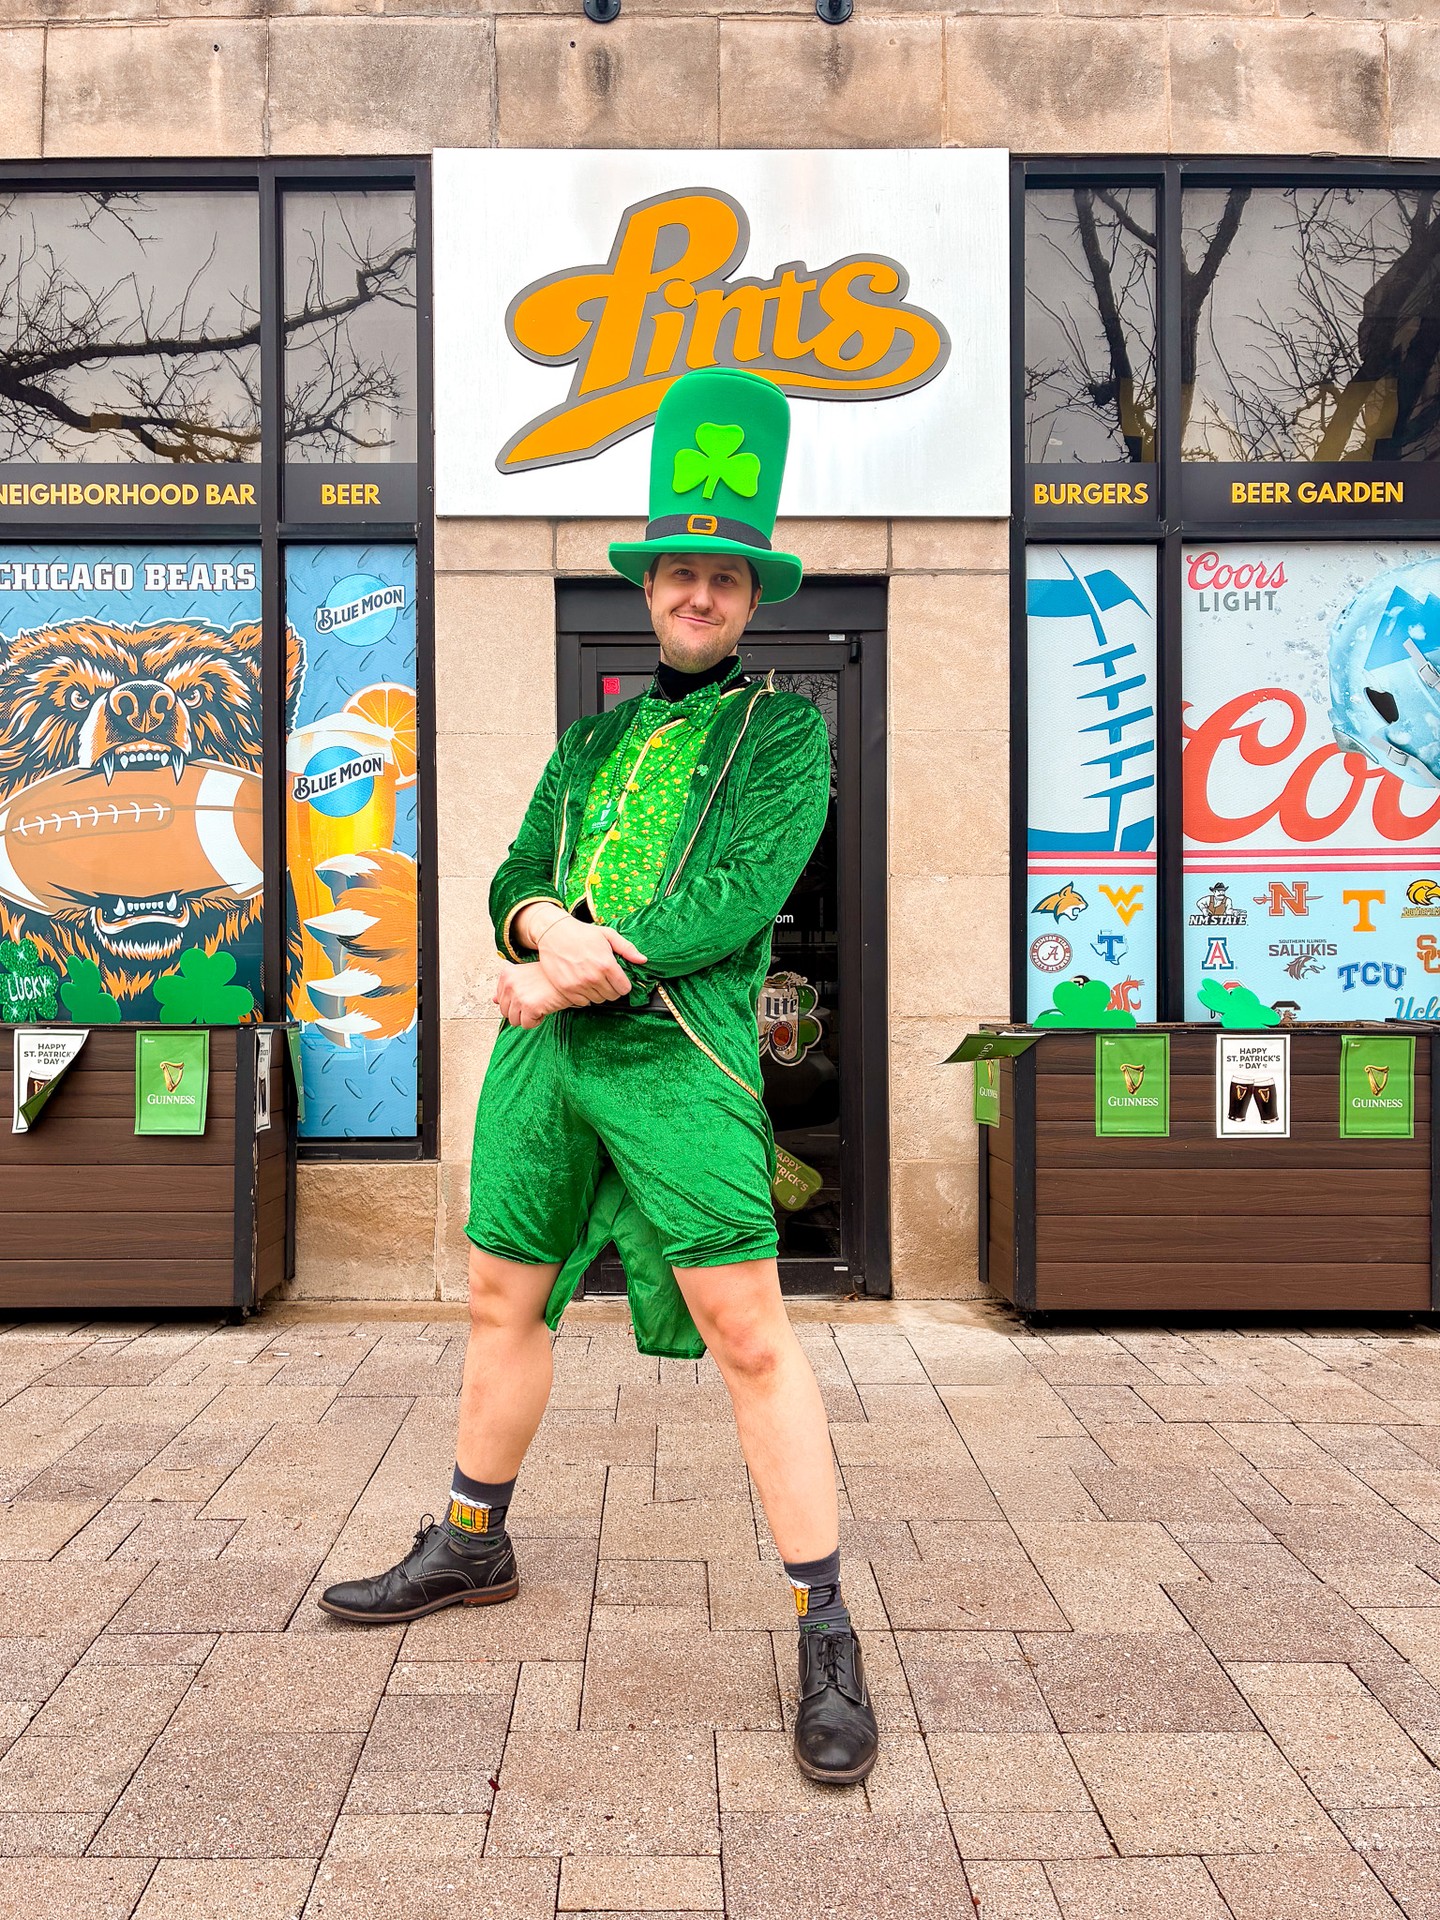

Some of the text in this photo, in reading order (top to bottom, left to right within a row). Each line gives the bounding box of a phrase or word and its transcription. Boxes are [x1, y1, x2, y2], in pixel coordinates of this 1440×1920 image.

[497, 188, 950, 471] Pints
[205, 483, 257, 505] BAR
[321, 483, 382, 505] BEER
[1034, 482, 1149, 505] BURGERS
[1231, 481, 1404, 504] BEER GARDEN
[0, 563, 256, 591] CHICAGO BEARS
[1186, 551, 1288, 590] Coors
[316, 589, 404, 632] BLUE MOON
[1199, 590, 1277, 612] LIGHT
[293, 756, 383, 800] BLUE MOON
[1268, 881, 1309, 916] N
[1189, 914, 1248, 926] NM STATE
[1342, 890, 1386, 932] T
[1201, 937, 1235, 970] A
[1268, 944, 1338, 956] SALUKIS
[7, 971, 49, 1002] LUCKY
[1337, 961, 1407, 993] TCU
[765, 996, 797, 1019] Lite
[1239, 1047, 1267, 1055] HAPPY
[147, 1093, 196, 1105] GUINNESS
[1107, 1096, 1159, 1107] GUINNESS
[1352, 1098, 1404, 1109] GUINNESS
[776, 1149, 801, 1172] APPY
[776, 1162, 809, 1192] TRICK'S
